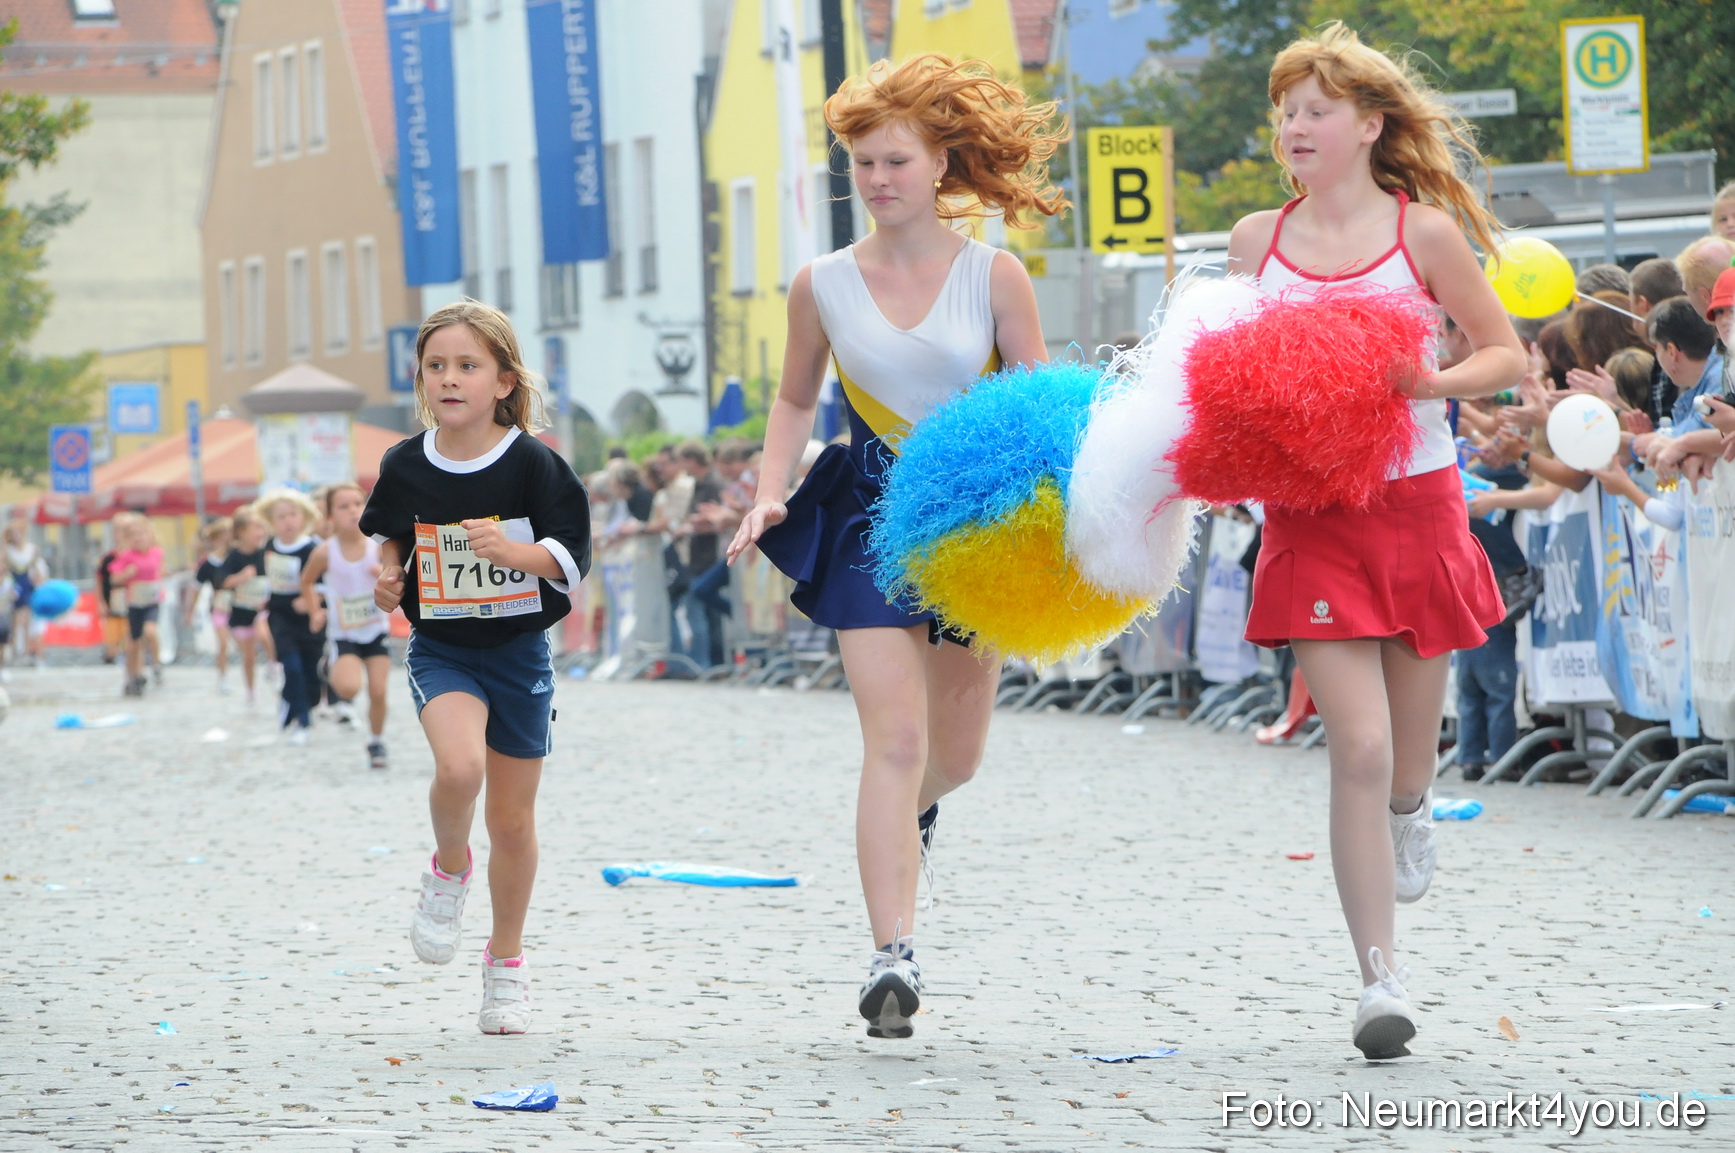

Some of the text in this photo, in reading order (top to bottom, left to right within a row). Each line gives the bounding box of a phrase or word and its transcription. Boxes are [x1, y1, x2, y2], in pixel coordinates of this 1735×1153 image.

[560, 0, 594, 141] RUPPERT
[1590, 43, 1617, 75] H
[1099, 133, 1162, 156] Block
[1113, 168, 1151, 224] B
[422, 560, 432, 575] K1
[493, 597, 540, 611] PFLEIDERER
